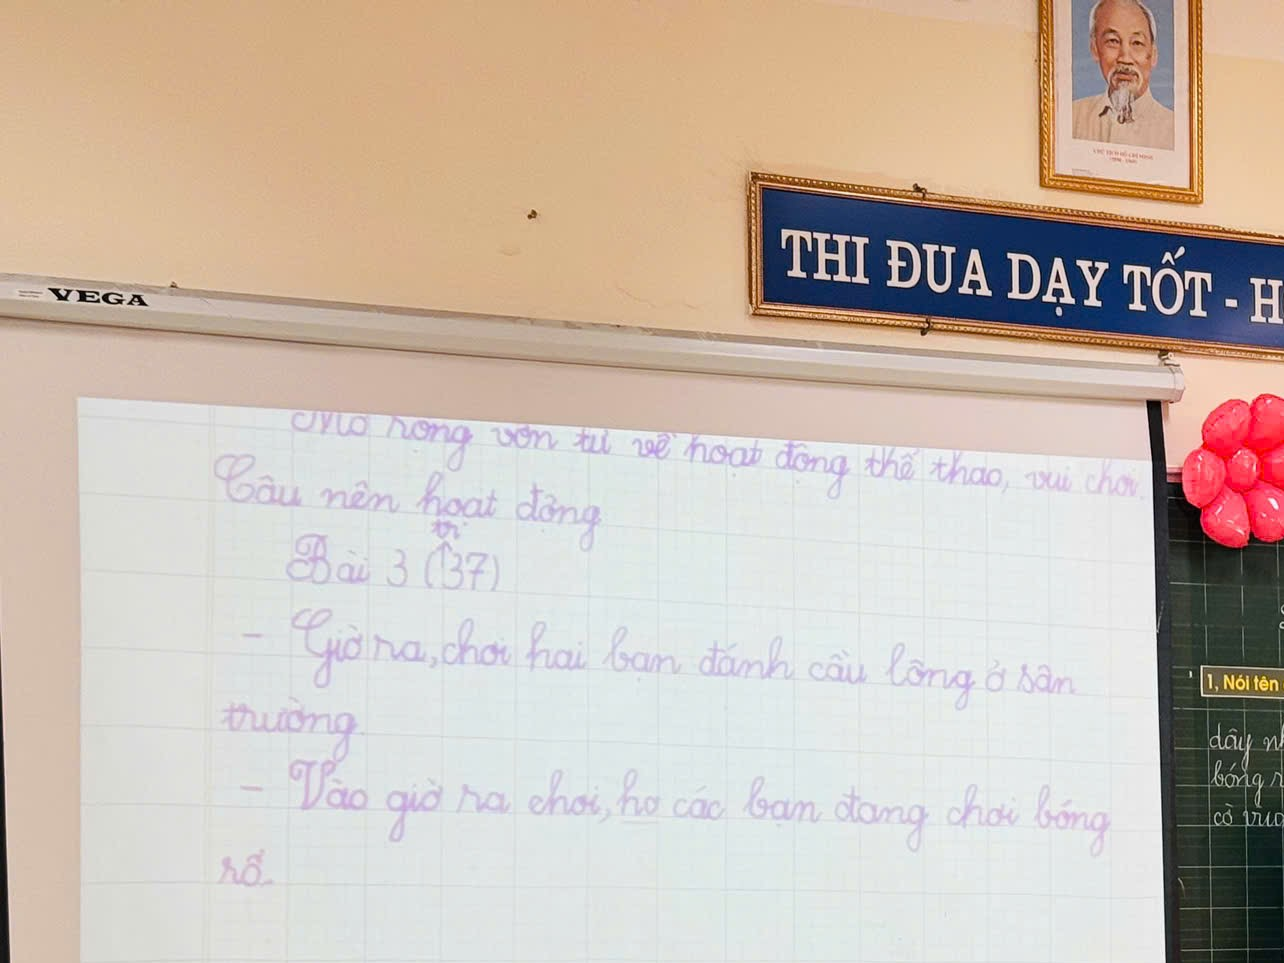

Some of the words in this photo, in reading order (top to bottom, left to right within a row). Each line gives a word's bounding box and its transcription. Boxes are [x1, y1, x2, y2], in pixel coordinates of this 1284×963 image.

[48, 287, 149, 307] VEGA
[781, 227, 869, 285] THI
[886, 238, 992, 297] ĐUA
[1007, 252, 1109, 317] DẠY
[1123, 246, 1213, 319] TỐT
[214, 454, 302, 507] Câu
[1024, 466, 1073, 493] vui
[286, 533, 371, 585] Bài
[386, 548, 409, 588] 3
[291, 607, 364, 689] Giờ
[525, 620, 587, 672] hai
[699, 635, 794, 681] đánh
[807, 649, 869, 685] cầu
[884, 642, 976, 711] lông
[985, 660, 1005, 693] ở
[1015, 658, 1078, 695] sân
[1223, 673, 1250, 691] Nói
[1253, 675, 1279, 692] tên
[220, 696, 358, 762] trường
[1209, 722, 1253, 771] dây
[288, 759, 370, 811] Vào
[386, 777, 443, 842] giờ
[456, 783, 511, 814] ra
[672, 784, 727, 821] các
[833, 786, 929, 852] đang
[946, 783, 1020, 827] chơi
[1033, 784, 1112, 857] bóng
[1211, 759, 1264, 807] bóng
[1213, 803, 1233, 826] cờ
